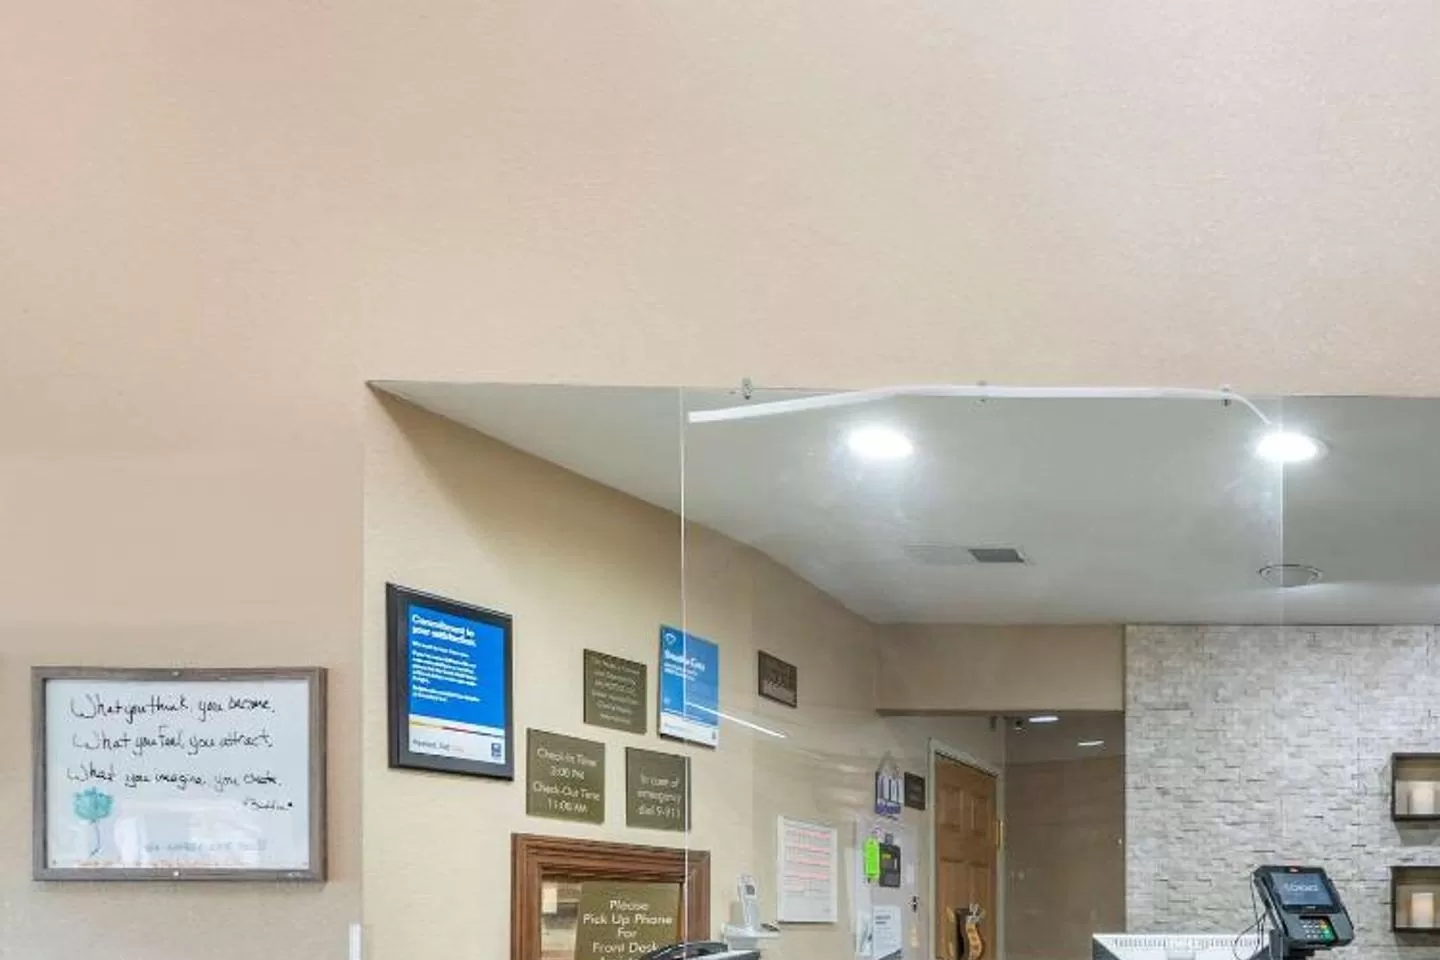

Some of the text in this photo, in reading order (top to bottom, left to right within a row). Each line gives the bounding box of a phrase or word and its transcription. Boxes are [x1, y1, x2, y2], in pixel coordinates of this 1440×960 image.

[70, 693, 122, 719] What
[124, 704, 146, 724] you
[198, 700, 223, 723] you
[72, 730, 131, 751] What
[132, 737, 157, 756] you
[188, 736, 215, 756] you
[576, 753, 598, 768] Time
[67, 760, 115, 782] What
[124, 774, 151, 788] you
[214, 774, 240, 793] you
[571, 769, 585, 780] PM
[580, 788, 601, 801] Time
[574, 803, 588, 814] AM
[609, 899, 649, 912] Please
[583, 912, 673, 927] Pick Up Phone
[617, 926, 637, 938] For
[592, 941, 660, 954] Front Desk
